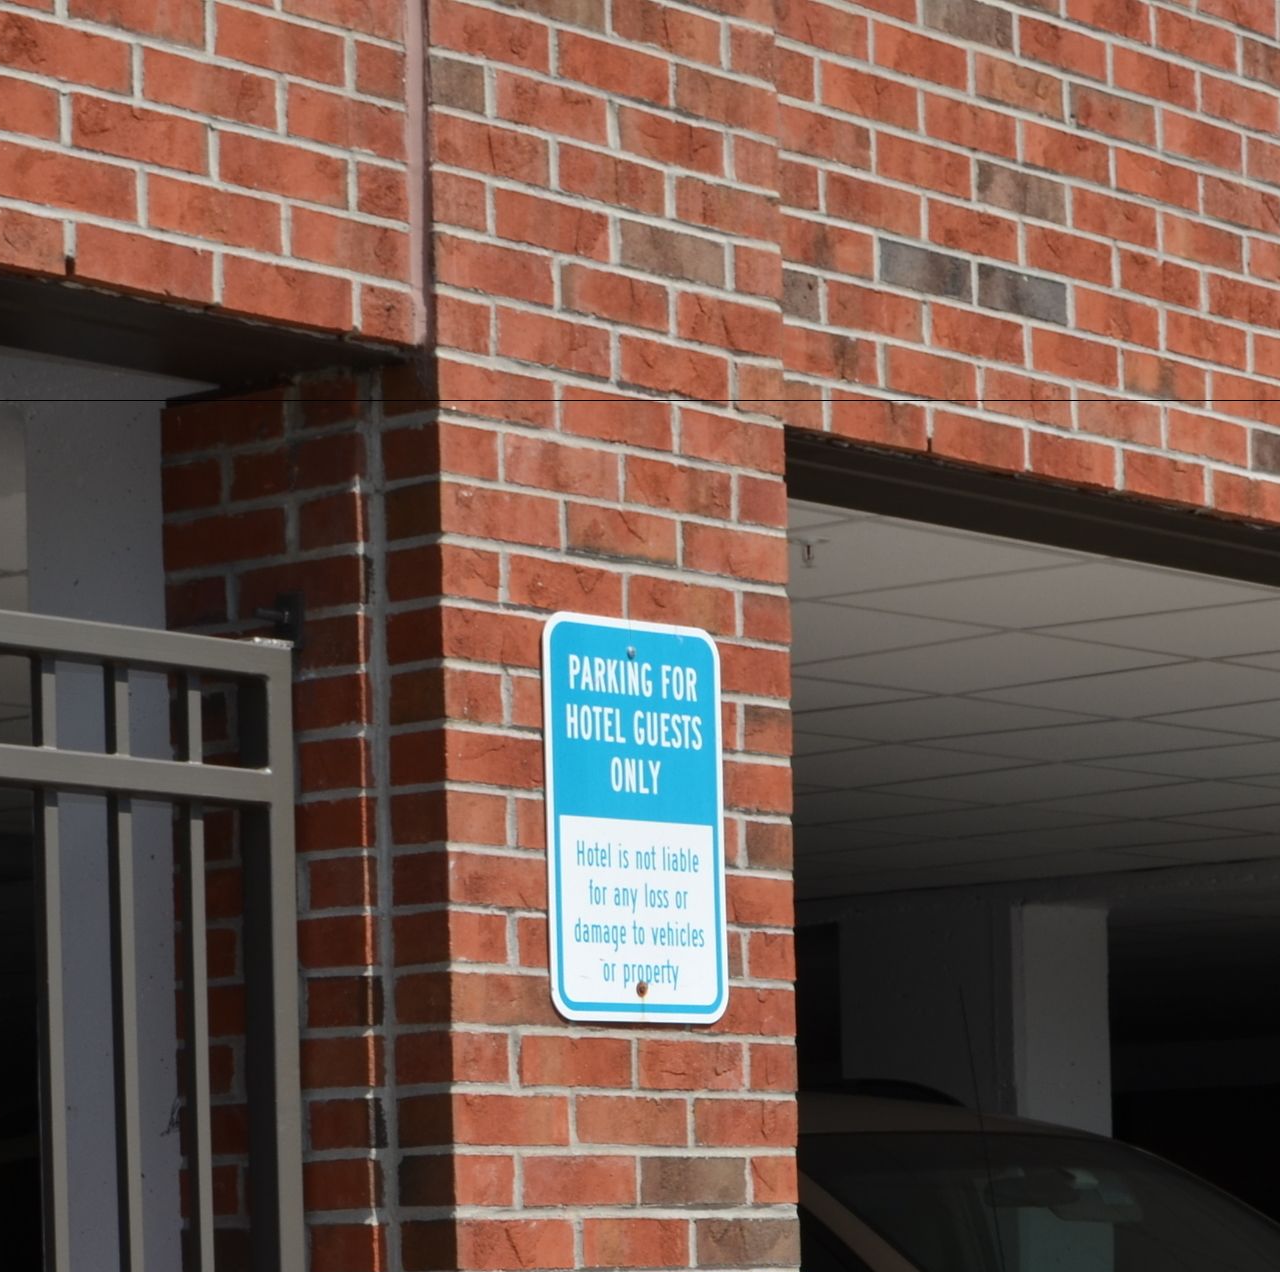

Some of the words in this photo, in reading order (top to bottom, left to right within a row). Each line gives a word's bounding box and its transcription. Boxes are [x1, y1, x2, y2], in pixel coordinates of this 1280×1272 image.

[568, 654, 653, 698] PARKING
[661, 664, 698, 702] FOR
[566, 703, 626, 744] HOTEL
[633, 710, 703, 750] GUESTS
[610, 756, 661, 795] ONLY
[576, 840, 612, 868] Hotel
[618, 843, 629, 869] is
[636, 845, 656, 870] not
[662, 846, 699, 873] liable
[589, 879, 607, 905] for
[614, 887, 638, 914] any
[644, 883, 669, 909] loss
[675, 890, 688, 910] or
[574, 918, 626, 952] damage
[632, 920, 645, 945] to
[651, 921, 705, 948] vehicles
[603, 962, 616, 982] or
[623, 959, 679, 991] property
